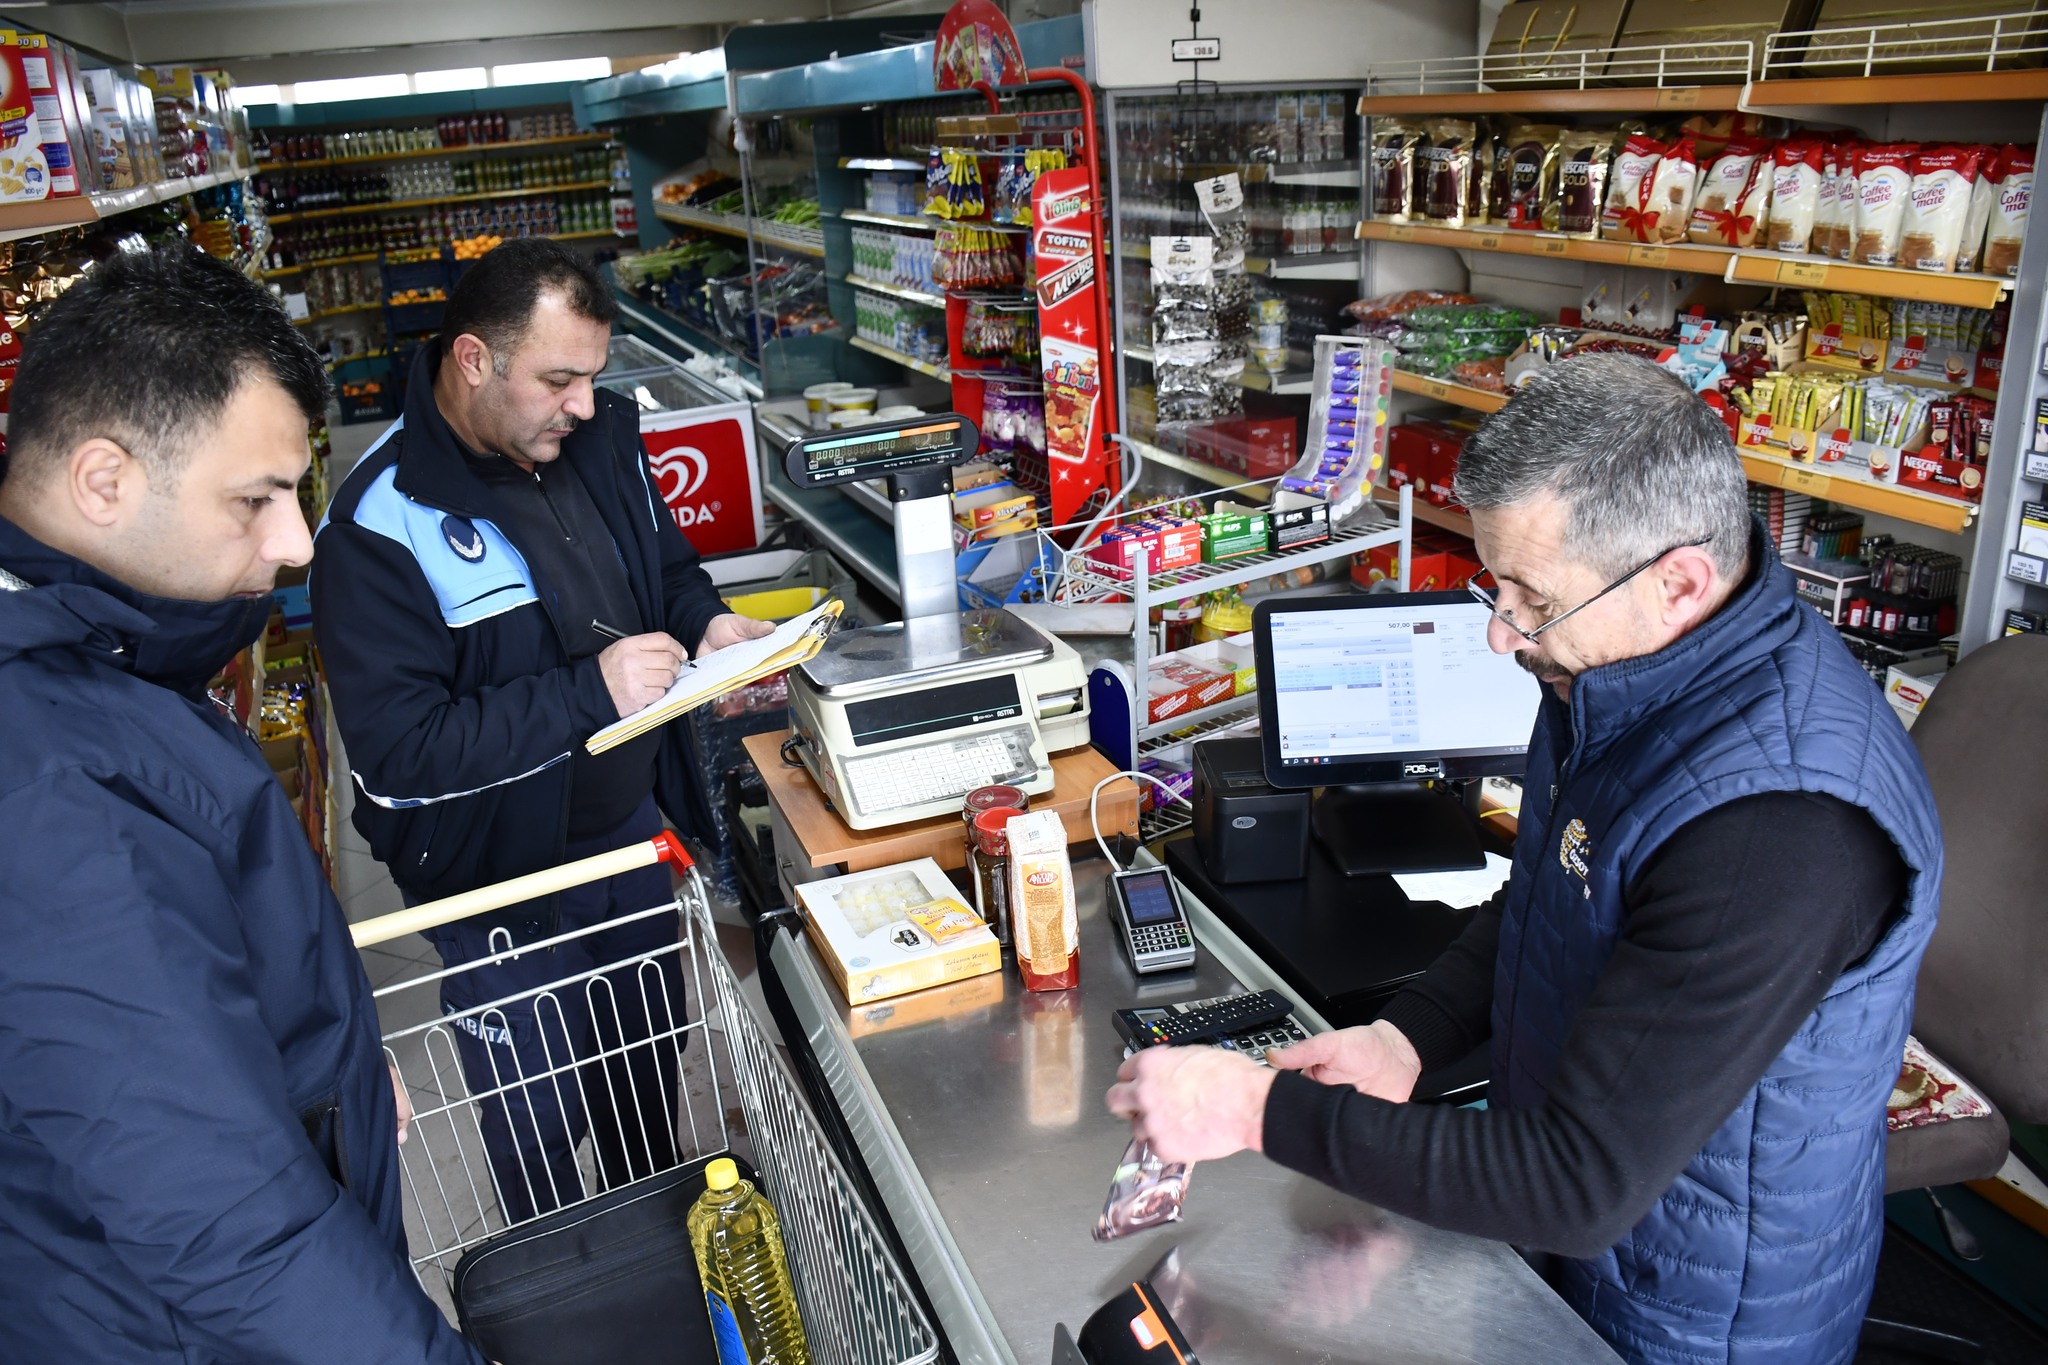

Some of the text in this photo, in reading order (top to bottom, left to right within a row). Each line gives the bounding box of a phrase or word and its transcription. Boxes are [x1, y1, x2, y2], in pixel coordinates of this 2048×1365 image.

[1776, 186, 1800, 197] mate
[1860, 185, 1892, 199] Coffee
[1912, 187, 1946, 201] Coffee
[1864, 193, 1892, 206] mate
[1916, 195, 1946, 208] mate
[1043, 360, 1094, 391] Jelibon
[838, 468, 856, 477] ASTRA
[997, 708, 1015, 718] ASTRA
